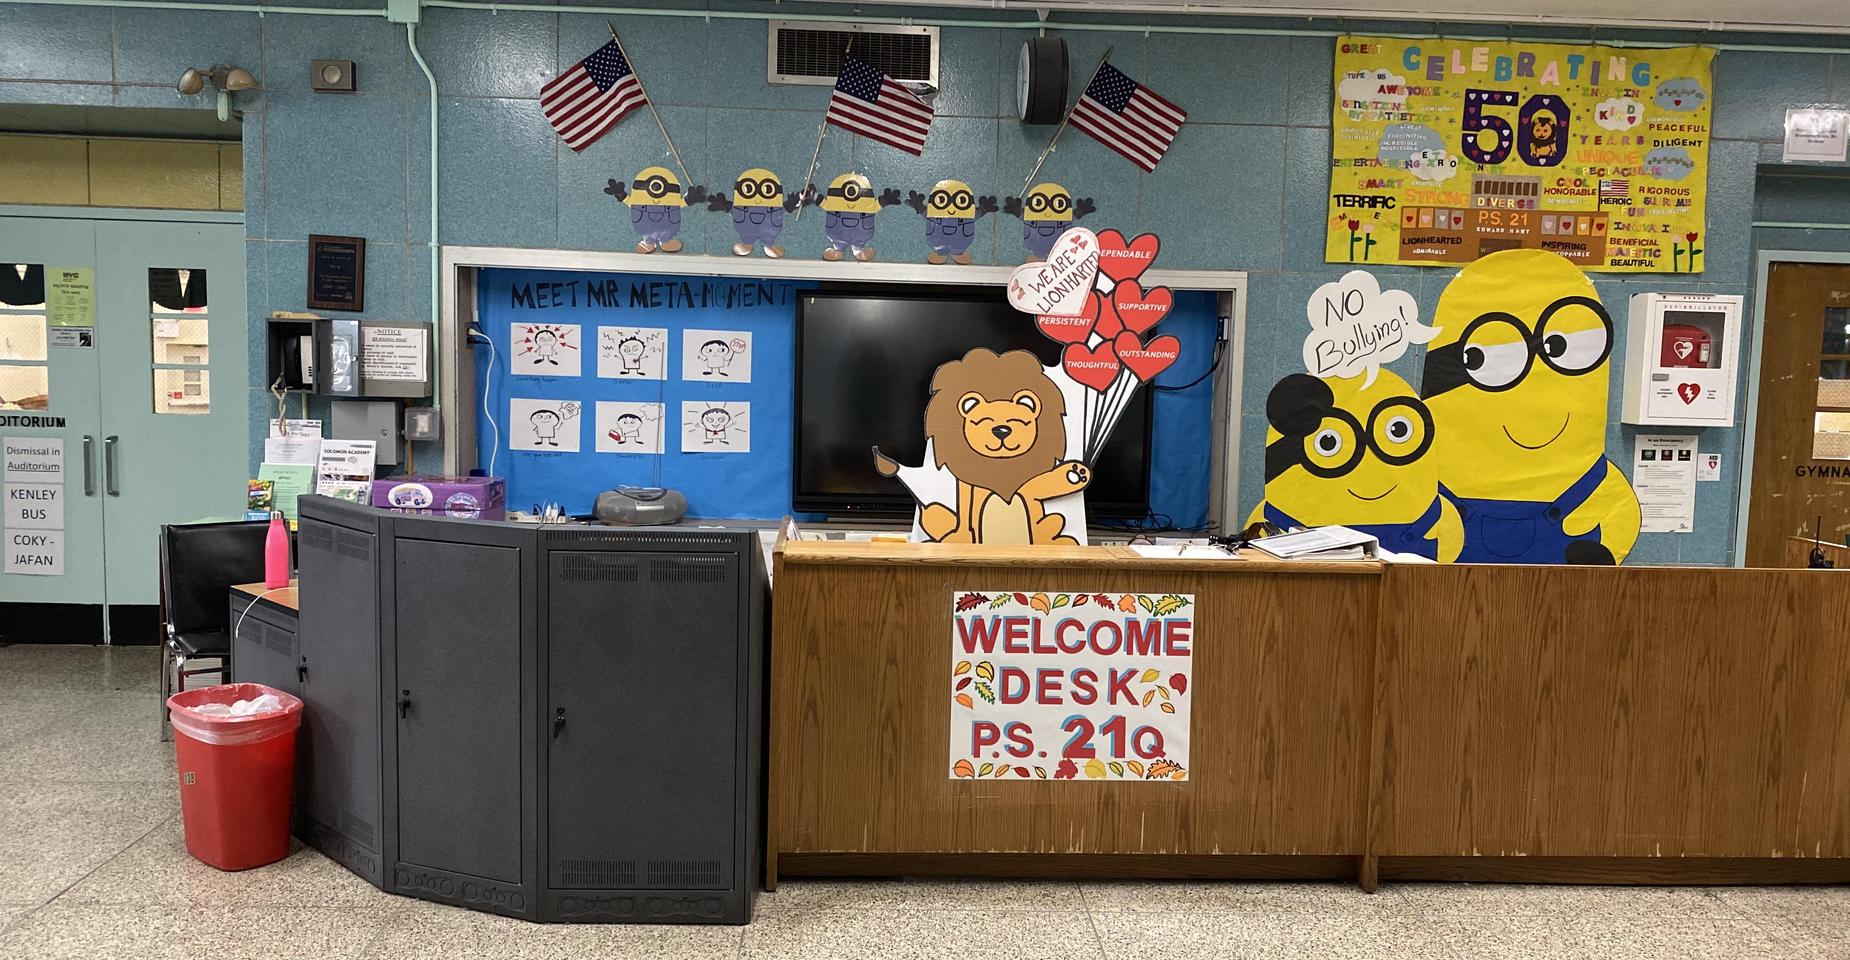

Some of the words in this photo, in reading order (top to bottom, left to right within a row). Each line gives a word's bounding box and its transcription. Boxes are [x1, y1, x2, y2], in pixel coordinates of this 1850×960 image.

[1341, 43, 1381, 55] GREAT
[1402, 46, 1651, 87] CELEBRATING
[1377, 85, 1441, 97] AWESOME
[1599, 104, 1636, 121] KIND
[1462, 88, 1571, 168] 50
[1648, 123, 1707, 133] PEACEFUL
[1580, 135, 1645, 146] YEARS
[1653, 137, 1703, 149] DILIGENT
[1576, 149, 1641, 164] UNIQUE
[1359, 178, 1404, 190] SMART
[1556, 177, 1589, 188] COOL
[1543, 187, 1597, 197] HONORABLE
[1638, 186, 1690, 196] RIGOROUS
[1333, 195, 1396, 210] TERRIFIC
[1405, 188, 1470, 207] STRONG
[1477, 197, 1535, 210] DIVERSE
[1600, 197, 1633, 206] HEROIC
[1478, 210, 1504, 226] P.S.
[1509, 212, 1529, 226] 21
[1621, 207, 1646, 218] FUN
[1475, 226, 1505, 234] EDWARD
[1509, 227, 1531, 235] HART
[1402, 236, 1463, 246] LIONHEARTED
[1541, 241, 1588, 252] INSPIRING
[1609, 237, 1659, 248] BENEFICIAL
[1100, 249, 1152, 260] EPENDABLE
[1412, 248, 1448, 257] ADMIRABLE
[1605, 246, 1662, 259] MAJESTIC
[1609, 259, 1657, 268] BEAUTIFUL
[1028, 268, 1054, 294] WE
[1050, 249, 1077, 277] ARE
[511, 280, 580, 309] MEET
[587, 279, 621, 308] MR
[629, 280, 792, 310] META-MOMENT
[1117, 302, 1168, 313] SUPPORTIVE
[1039, 316, 1092, 327] PERSISTENT
[1315, 305, 1409, 374] Bullying!
[1119, 350, 1177, 362] OUTSTANDING
[1066, 360, 1119, 371] THOUGHTFUL
[7, 446, 49, 456] Dismissal
[52, 446, 61, 456] in
[8, 461, 61, 471] Auditorium
[1795, 465, 1850, 478] GYMNA
[11, 489, 57, 501] KENLEY
[22, 509, 47, 520] BUS
[14, 534, 47, 546] COKY
[14, 554, 54, 566] JAFAN
[955, 614, 1192, 657] WELCOME
[999, 666, 1140, 705] DESK
[970, 720, 1048, 758] P.S.
[1060, 714, 1166, 759] 21Q
